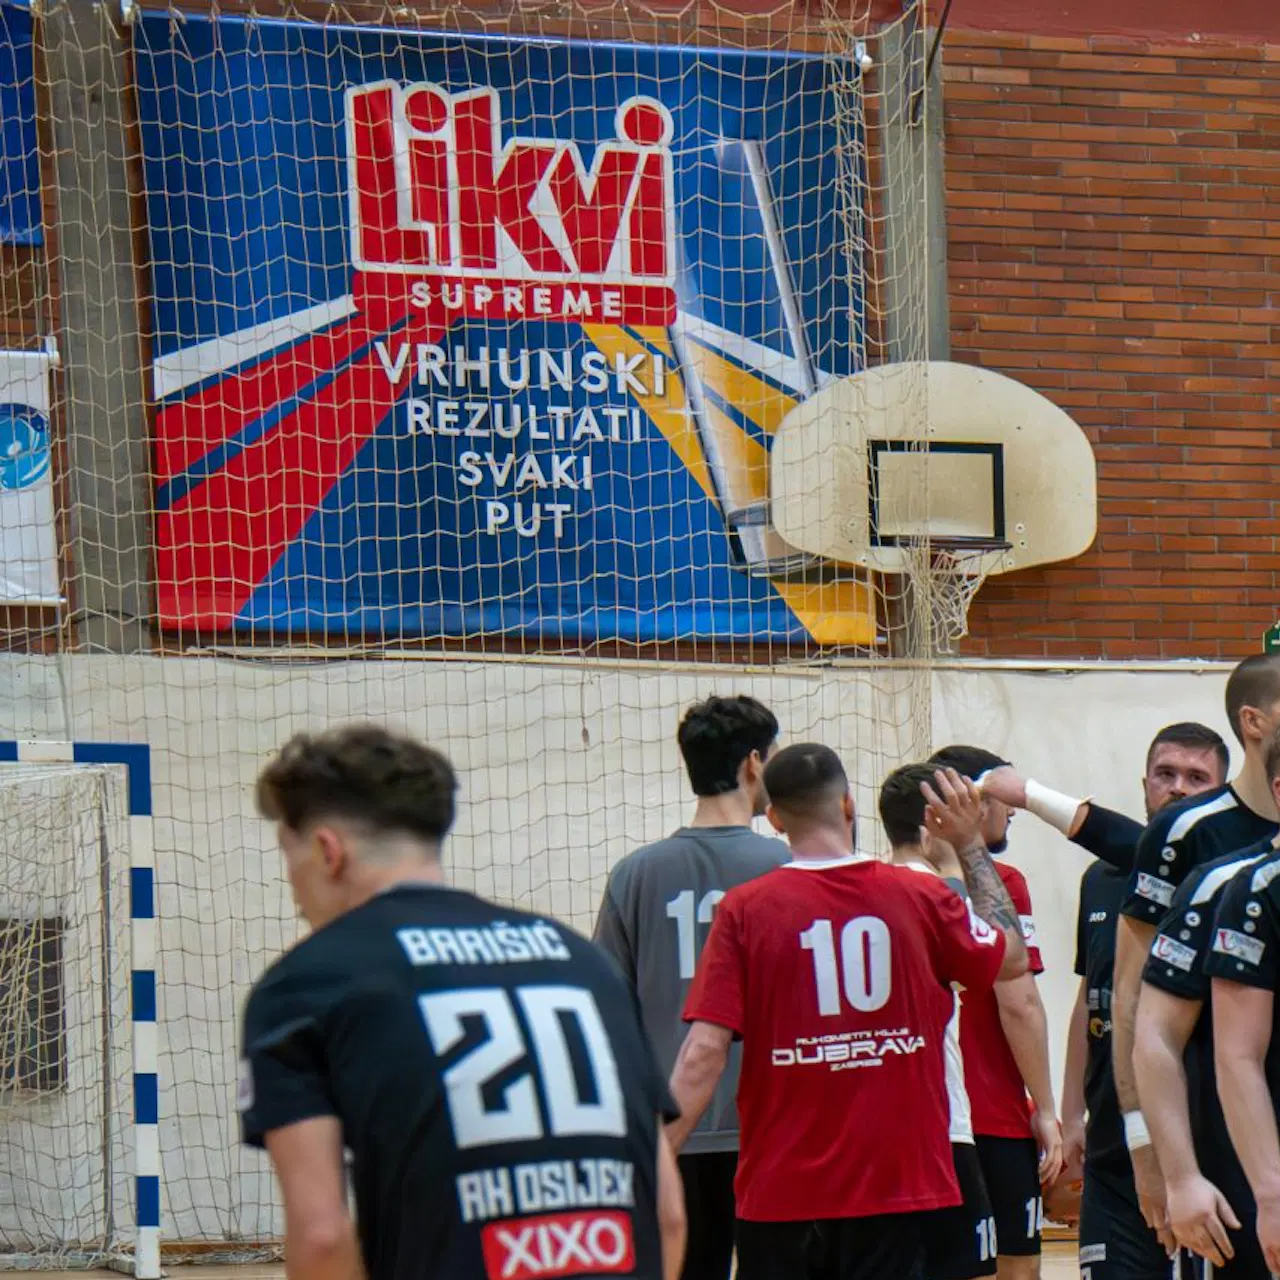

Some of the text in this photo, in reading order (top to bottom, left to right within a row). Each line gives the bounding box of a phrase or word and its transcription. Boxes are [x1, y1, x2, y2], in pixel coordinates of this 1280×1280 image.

[411, 282, 622, 318] SUPREME
[374, 341, 664, 396] VRHUNSKI
[406, 400, 641, 443] REZULTATI
[458, 451, 593, 491] SVAKI
[486, 501, 572, 538] PUT
[396, 920, 572, 966] BARIŠIĆ
[667, 890, 726, 980] 1
[800, 916, 893, 1017] 10
[418, 985, 628, 1149] 20
[772, 1036, 926, 1066] DUBRAVA
[515, 1157, 635, 1213] OSIJEK
[496, 1218, 626, 1278] XIXO
